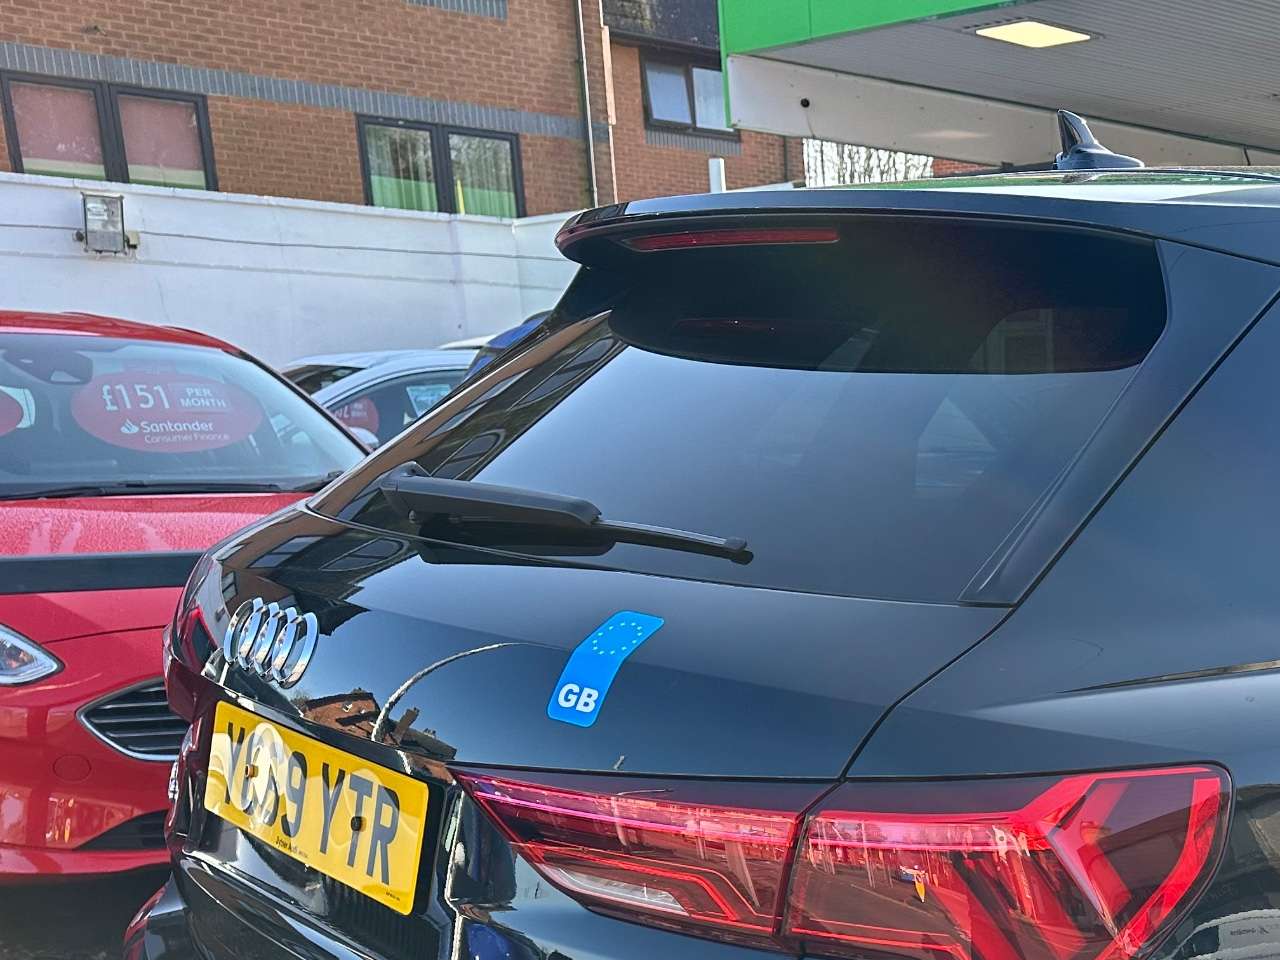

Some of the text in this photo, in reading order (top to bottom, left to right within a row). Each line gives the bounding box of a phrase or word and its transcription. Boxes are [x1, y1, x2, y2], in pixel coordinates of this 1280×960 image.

[102, 384, 170, 411] £151
[186, 387, 212, 397] PER
[180, 398, 226, 408] MONTH
[140, 420, 214, 434] Santander
[558, 683, 599, 713] GB
[320, 762, 401, 886] YTR
